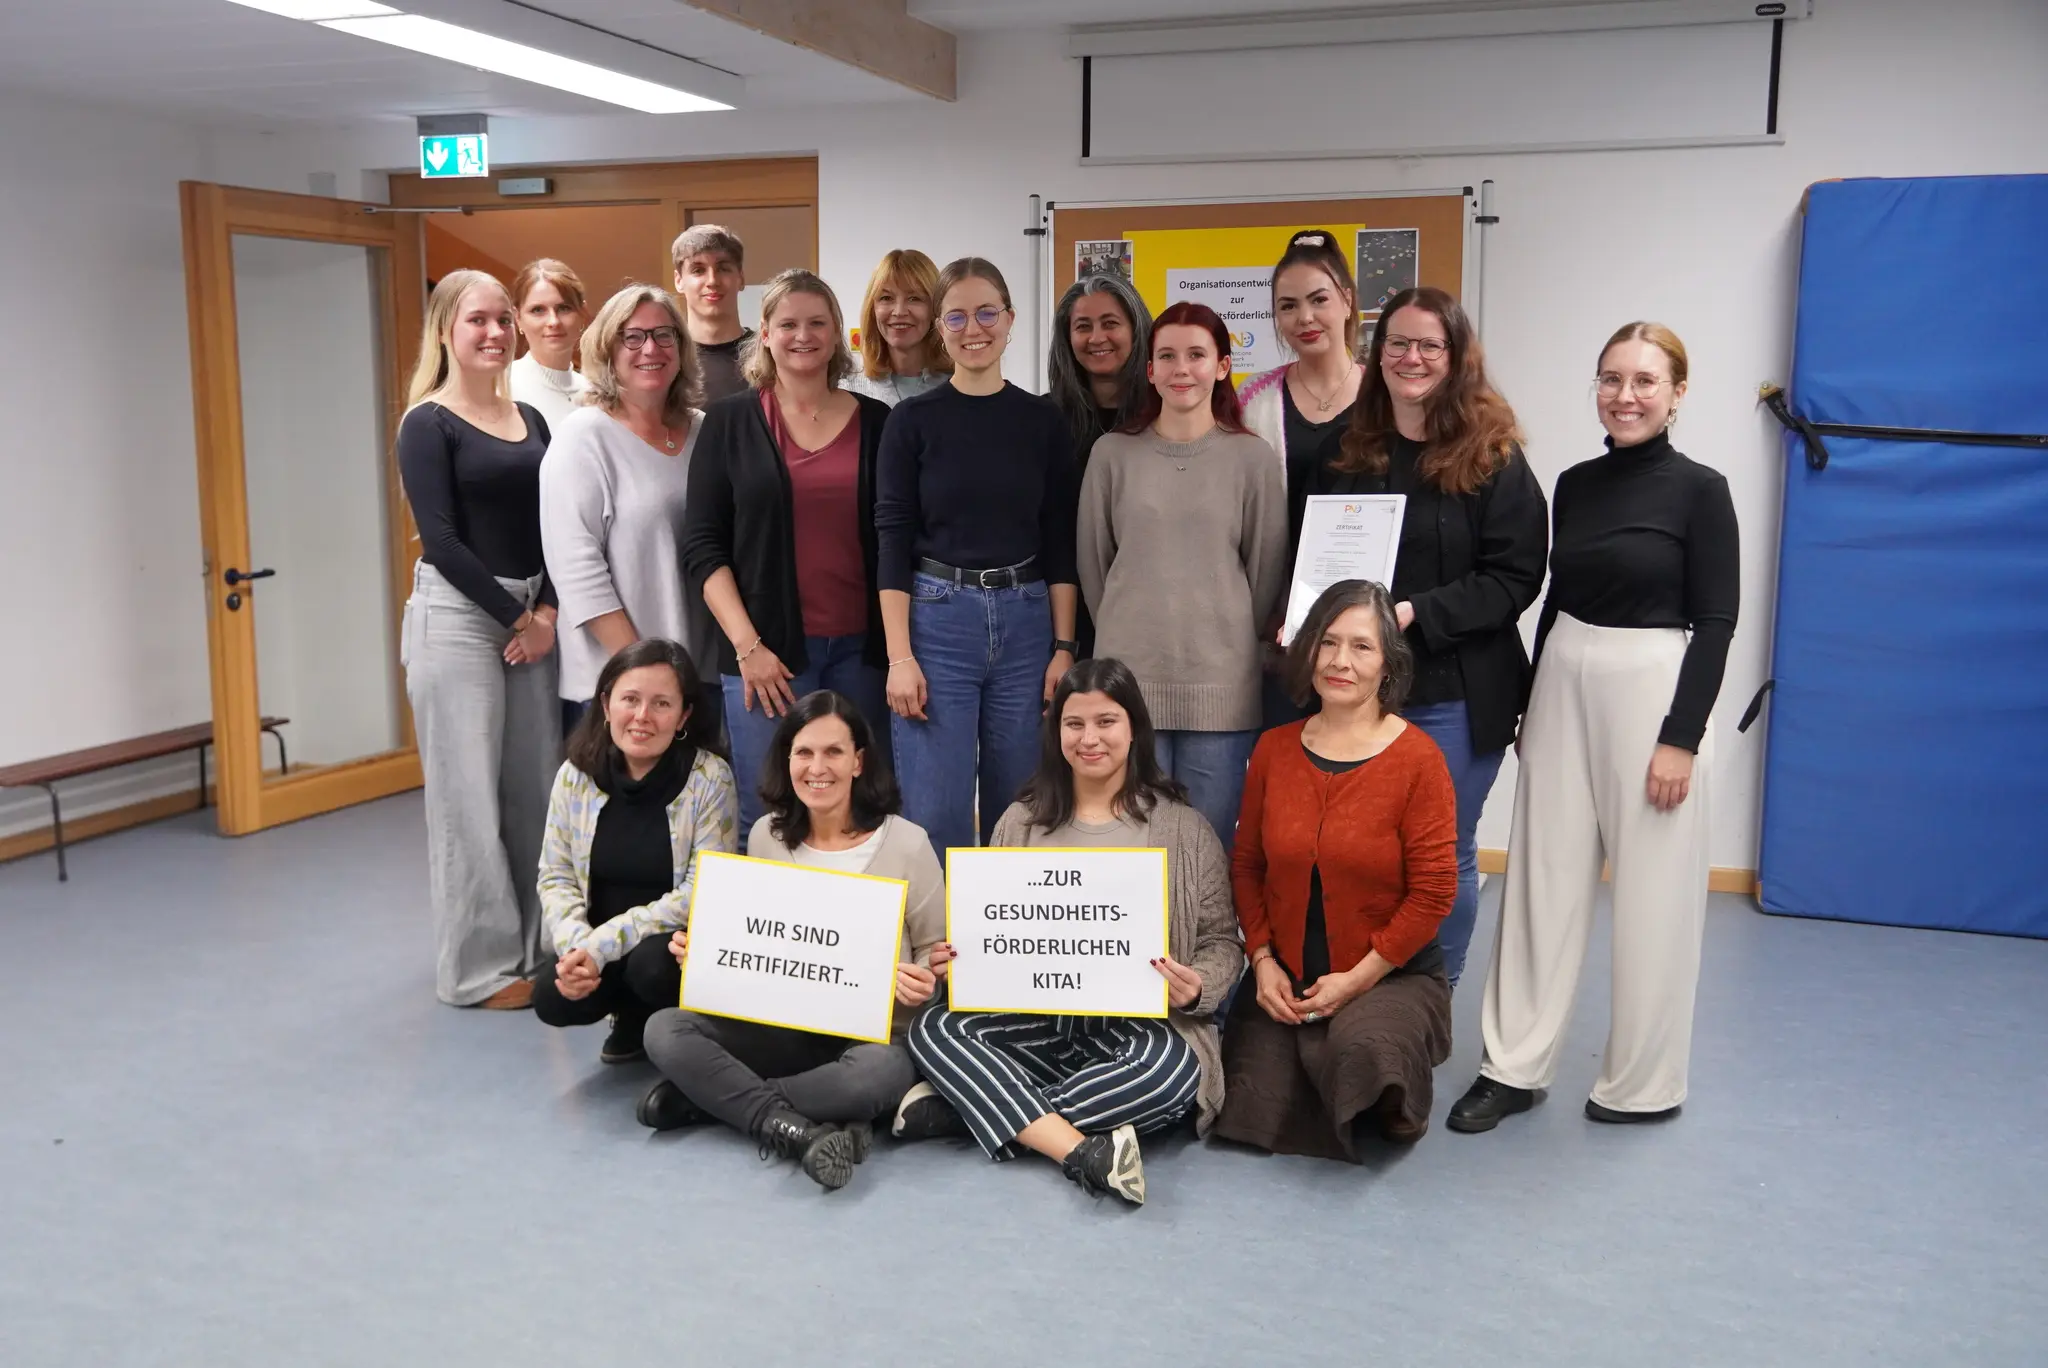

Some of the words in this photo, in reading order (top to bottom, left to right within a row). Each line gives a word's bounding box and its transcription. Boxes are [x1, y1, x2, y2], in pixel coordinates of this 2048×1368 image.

[1179, 279, 1273, 291] Organisationsentwic
[1230, 296, 1245, 304] zur
[984, 903, 1128, 922] GESUNDHEITS-
[746, 916, 786, 939] WIR
[791, 924, 840, 947] SIND
[983, 935, 1130, 956] FÖRDERLICHEN
[1033, 972, 1081, 990] KITA!
